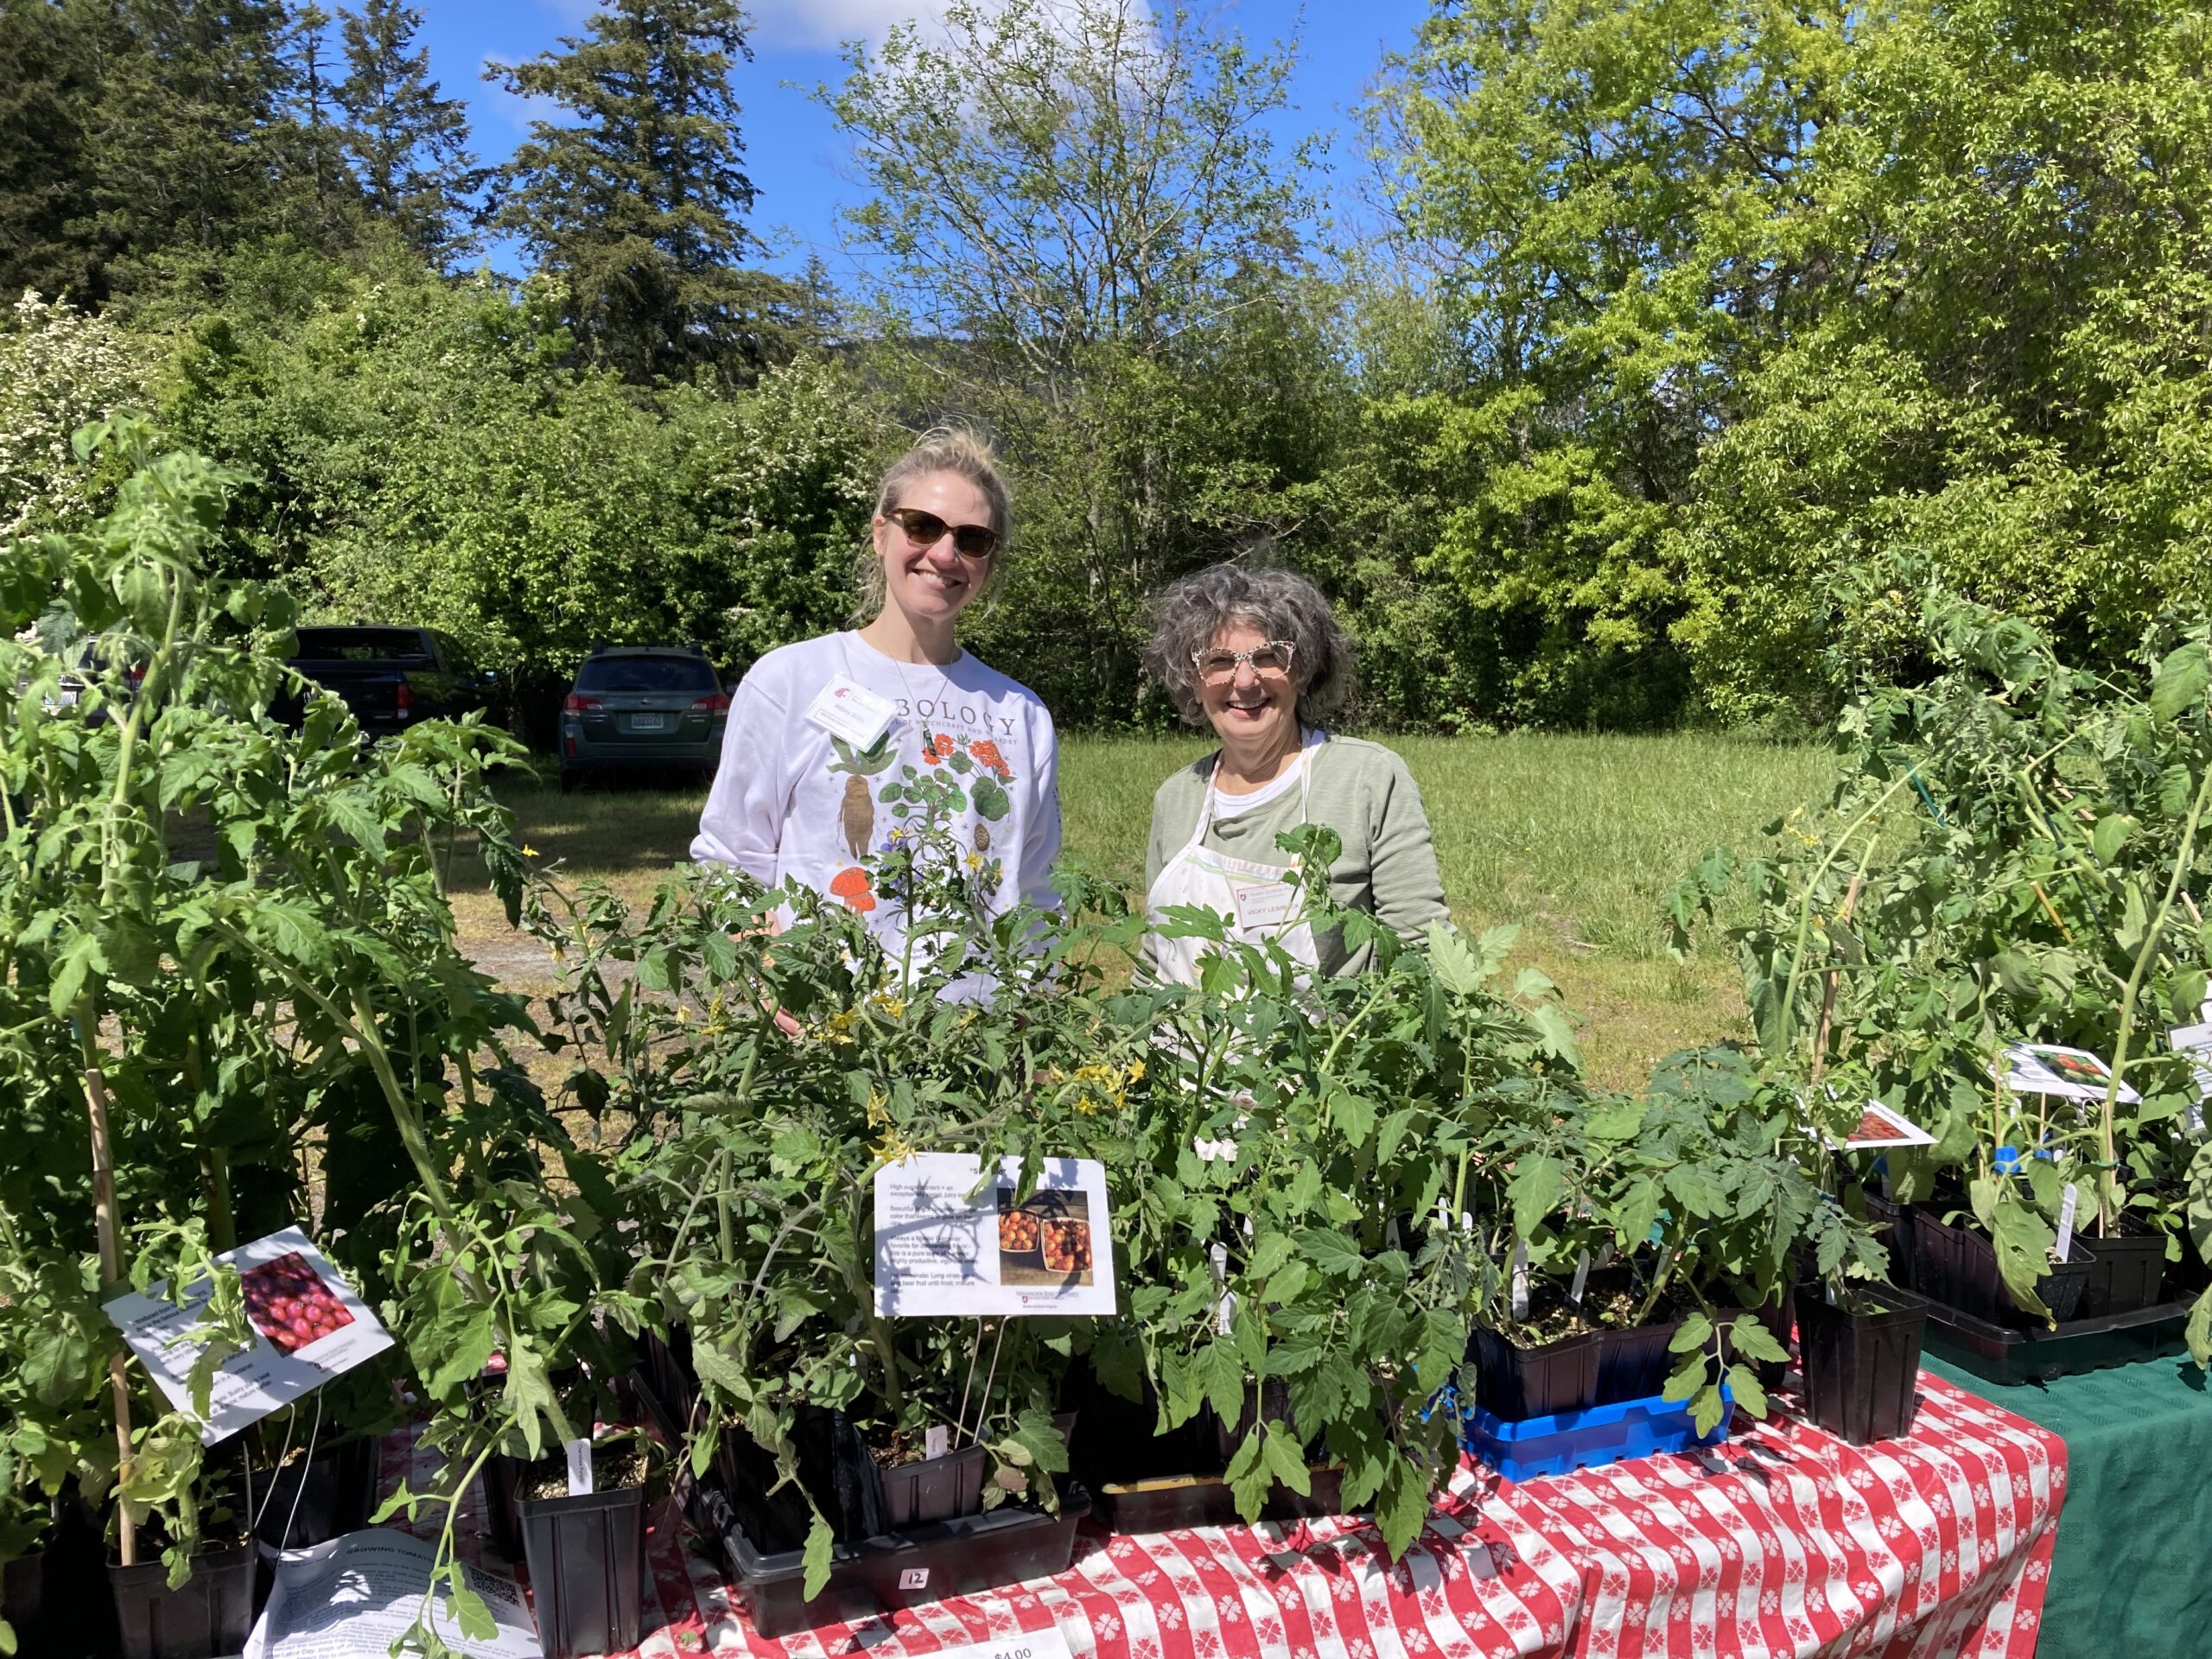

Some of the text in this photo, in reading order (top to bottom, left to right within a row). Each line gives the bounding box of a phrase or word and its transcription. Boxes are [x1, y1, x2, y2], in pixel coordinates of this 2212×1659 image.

[893, 698, 1016, 736] BOLOGY
[345, 1546, 396, 1555] GROWING
[908, 1572, 925, 1585] 12
